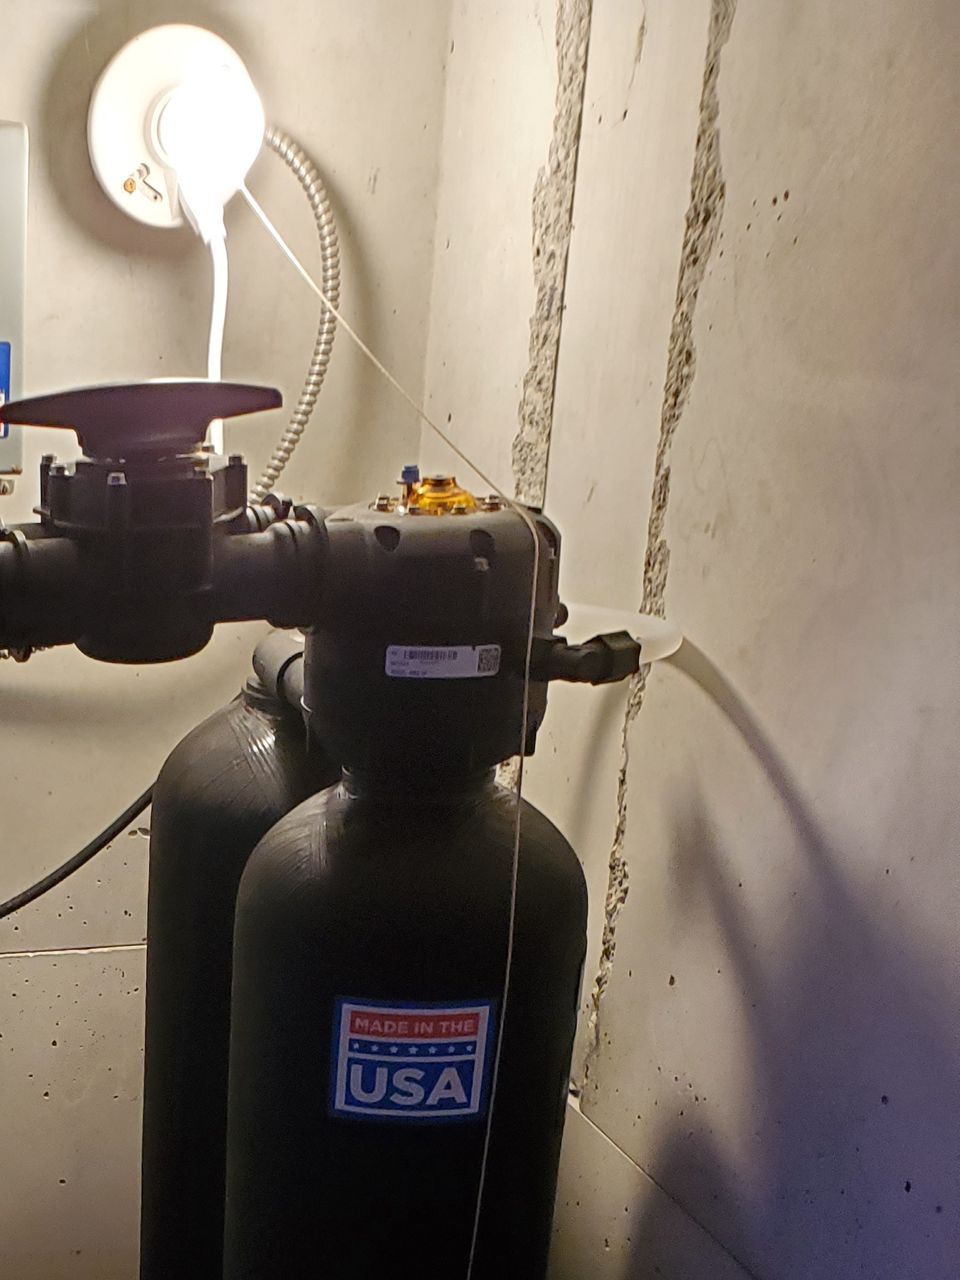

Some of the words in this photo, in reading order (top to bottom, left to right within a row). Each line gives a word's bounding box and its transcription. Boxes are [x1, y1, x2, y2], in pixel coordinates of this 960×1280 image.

[354, 1017, 409, 1034] MADE
[414, 1020, 434, 1034] IN
[440, 1018, 475, 1033] THE
[349, 1063, 469, 1106] USA
